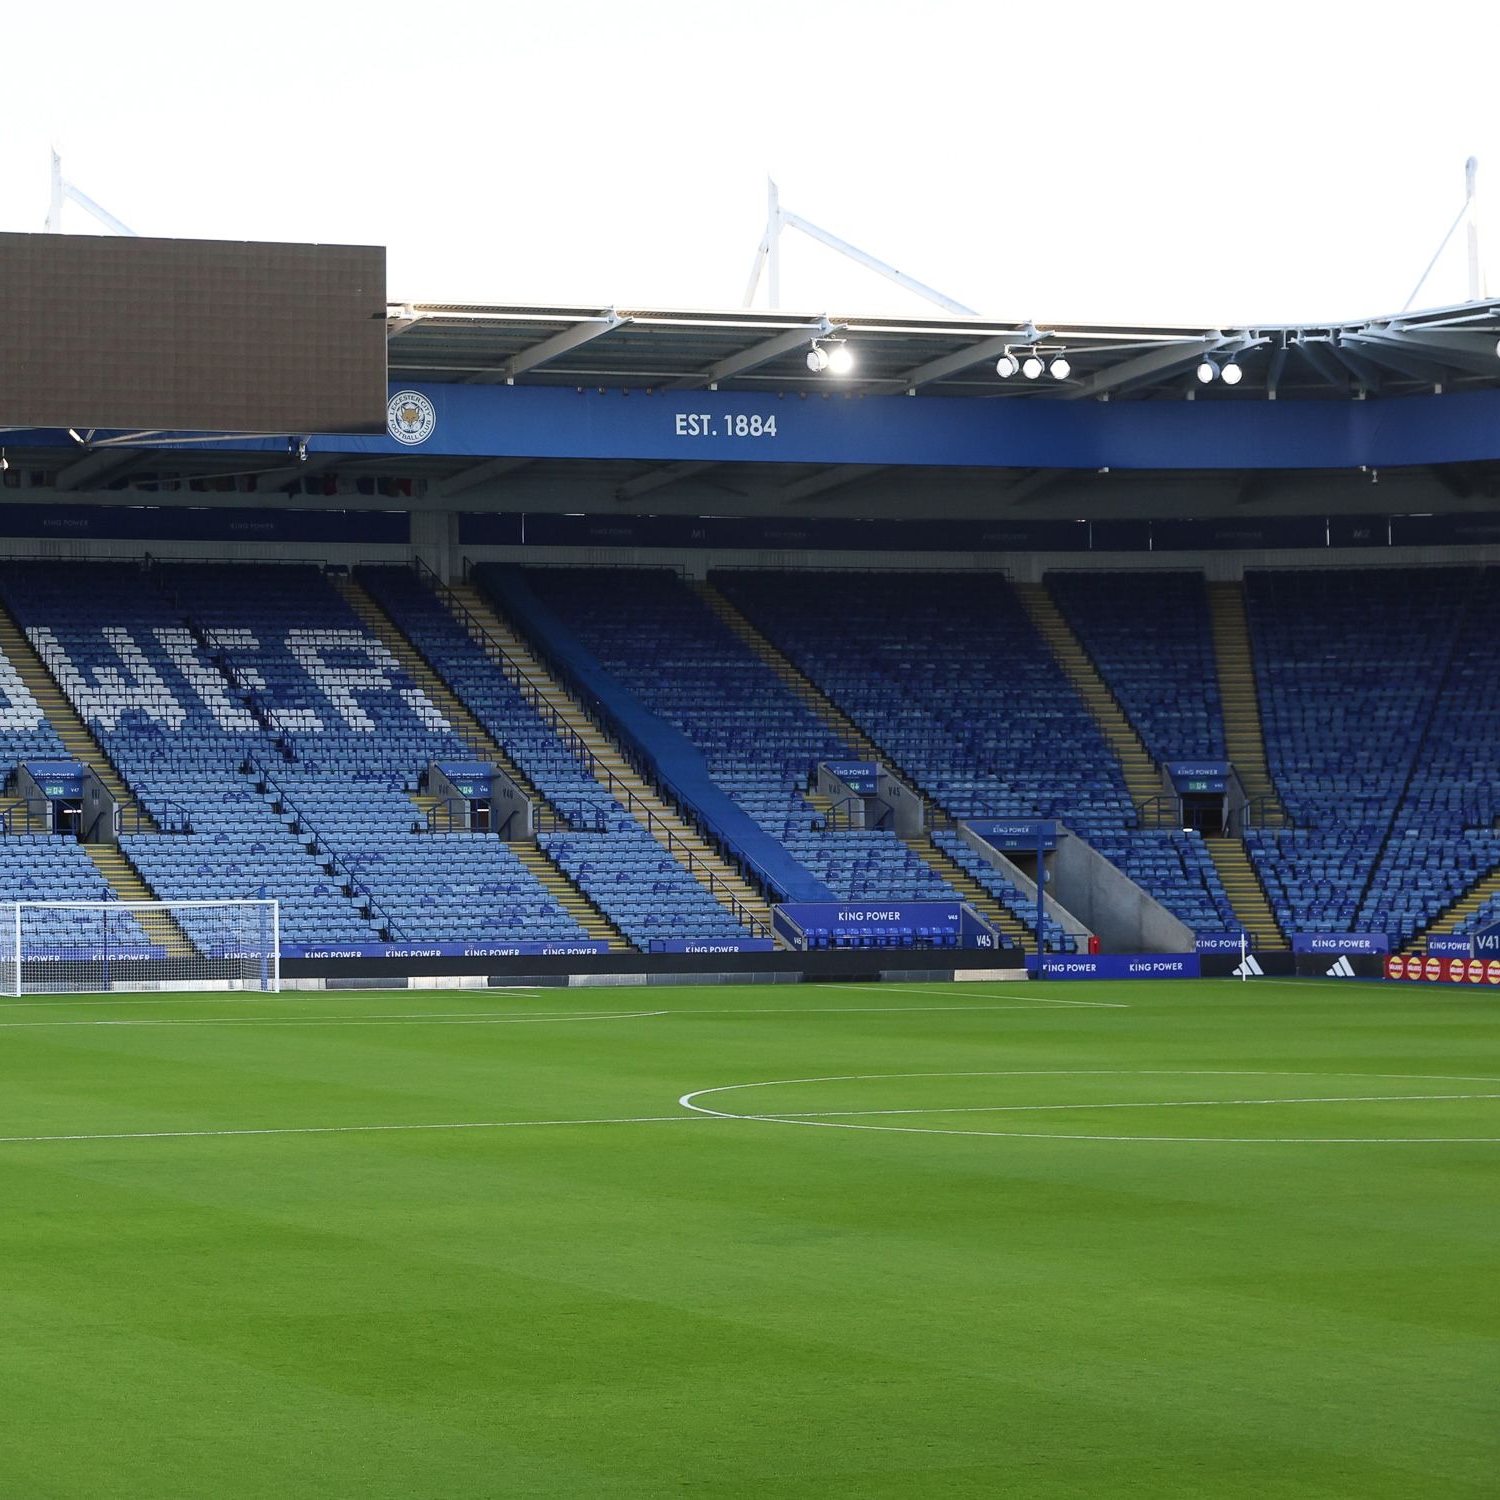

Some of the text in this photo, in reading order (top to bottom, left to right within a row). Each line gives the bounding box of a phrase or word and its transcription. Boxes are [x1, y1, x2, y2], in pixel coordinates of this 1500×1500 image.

[390, 395, 431, 416] LEICESTER CITY
[419, 420, 431, 437] CLUB
[675, 413, 777, 436] EST. 1884
[838, 912, 900, 920] KING POWER
[976, 935, 991, 946] V45
[1196, 940, 1218, 948] KING
[1338, 940, 1370, 948] POWER
[1477, 935, 1499, 949] V41
[1043, 964, 1096, 972] KING POWER
[1153, 963, 1183, 971] POWER
